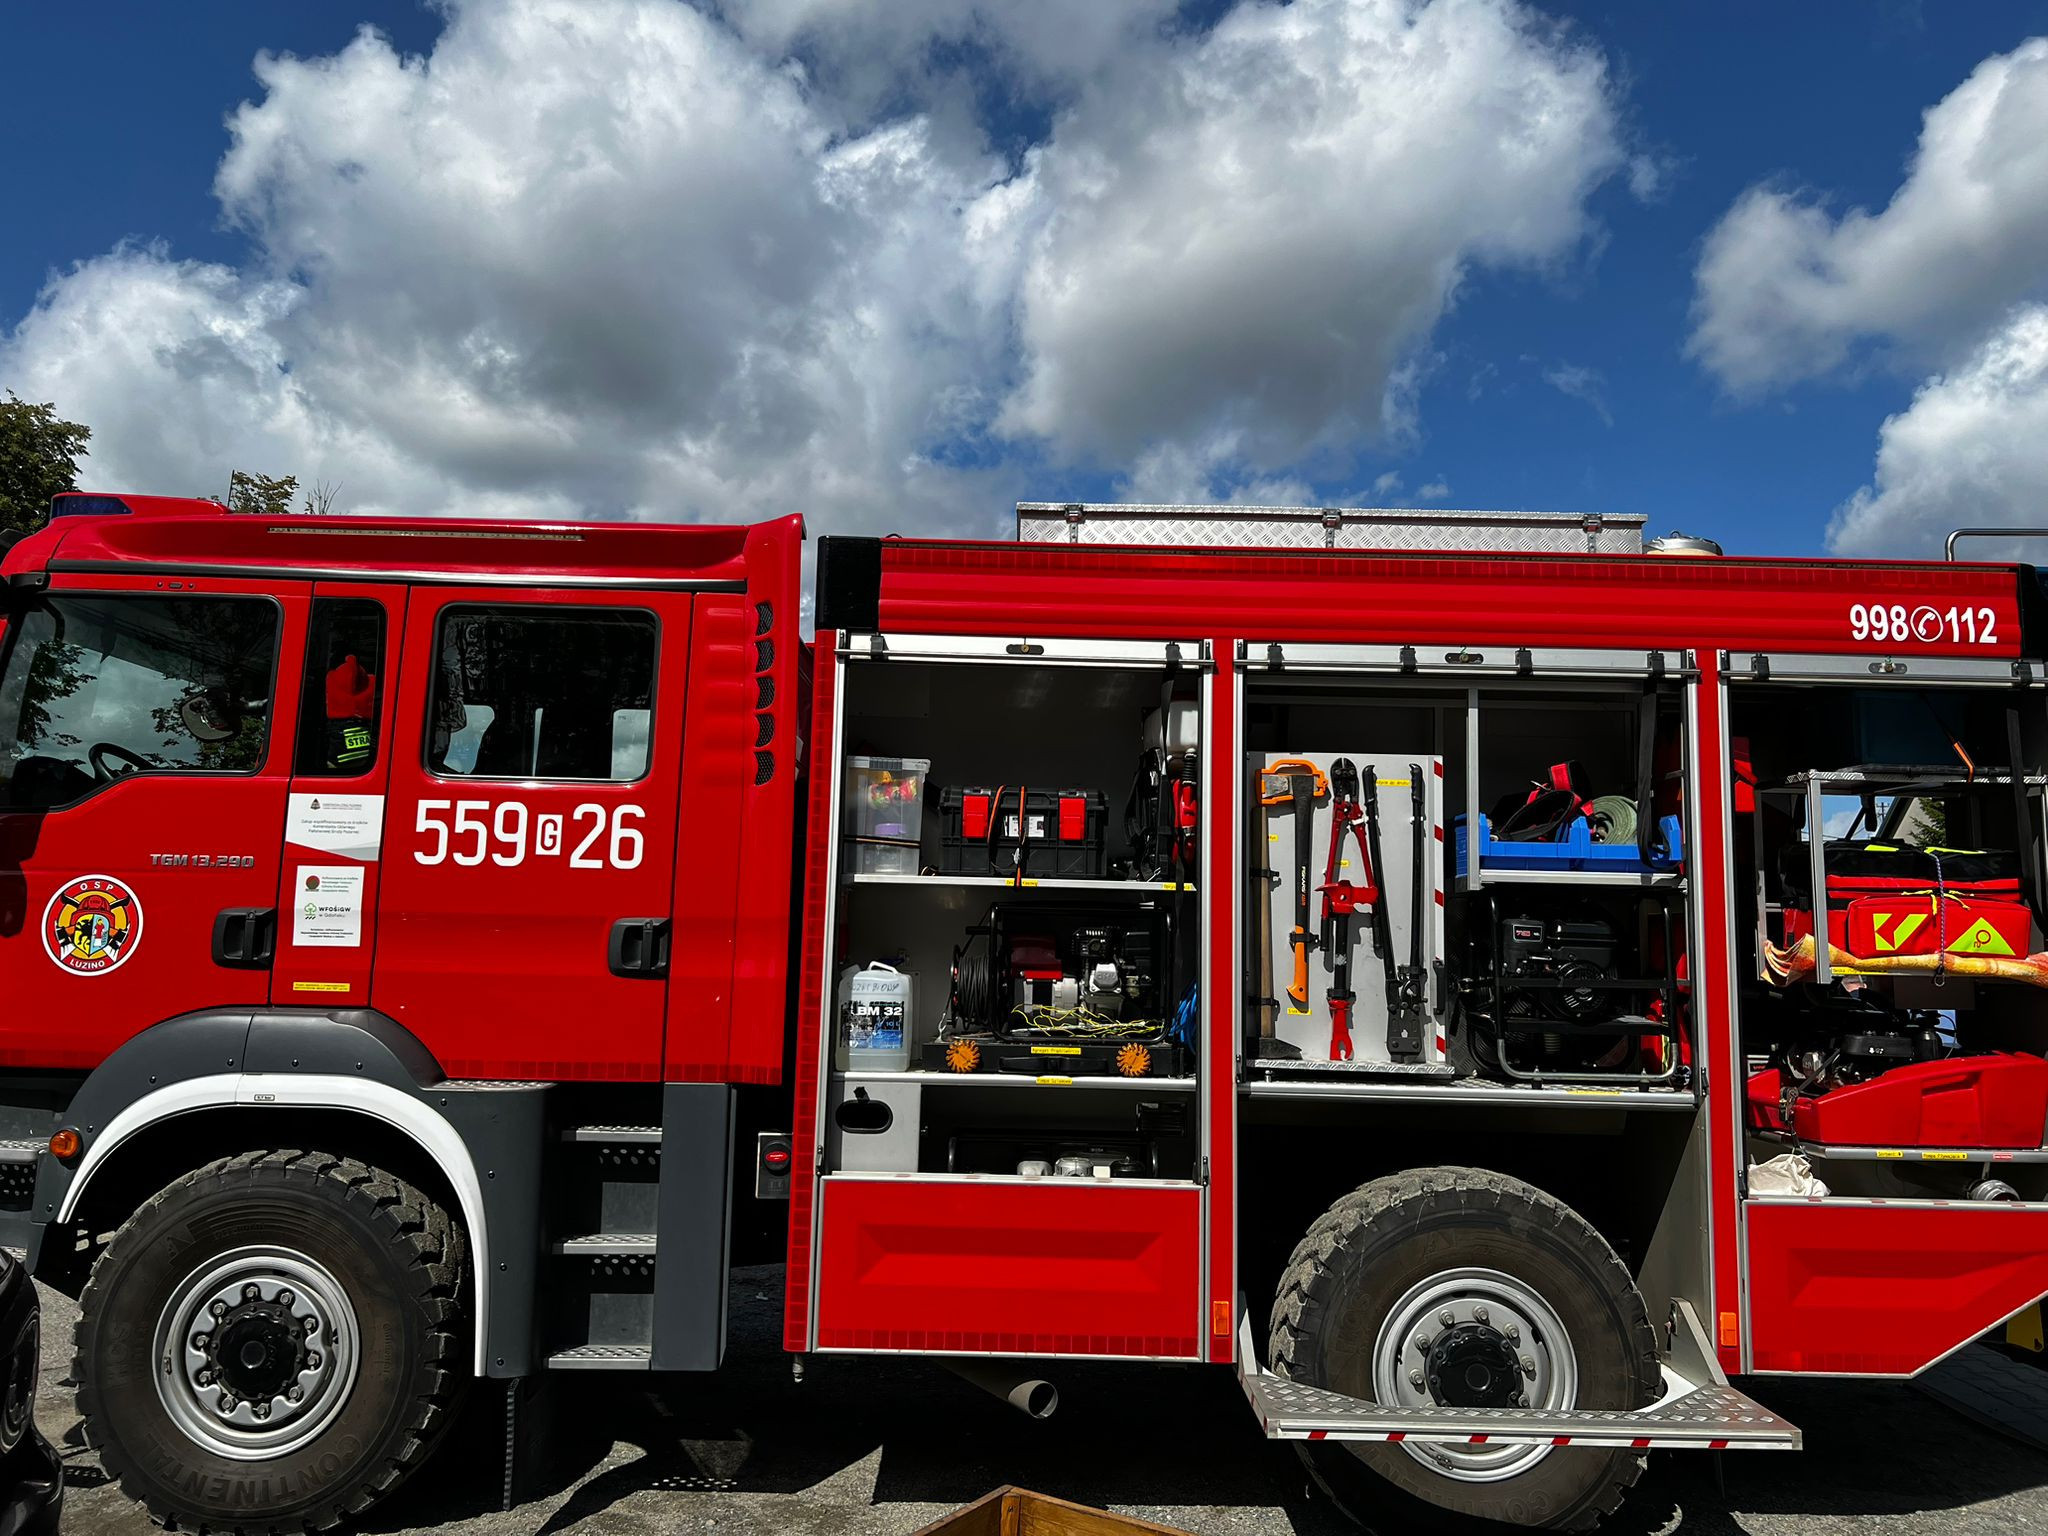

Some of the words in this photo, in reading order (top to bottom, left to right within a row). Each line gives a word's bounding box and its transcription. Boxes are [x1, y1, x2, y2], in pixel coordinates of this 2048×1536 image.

[1850, 604, 1909, 642] 998
[1945, 606, 1998, 644] 112
[413, 799, 528, 867] 559
[539, 817, 560, 852] G
[569, 803, 646, 870] 26
[150, 853, 187, 867] TGM
[191, 855, 255, 868] 13.290
[80, 881, 114, 891] OSP
[69, 959, 105, 969] LUZINO
[884, 1006, 903, 1016] 32
